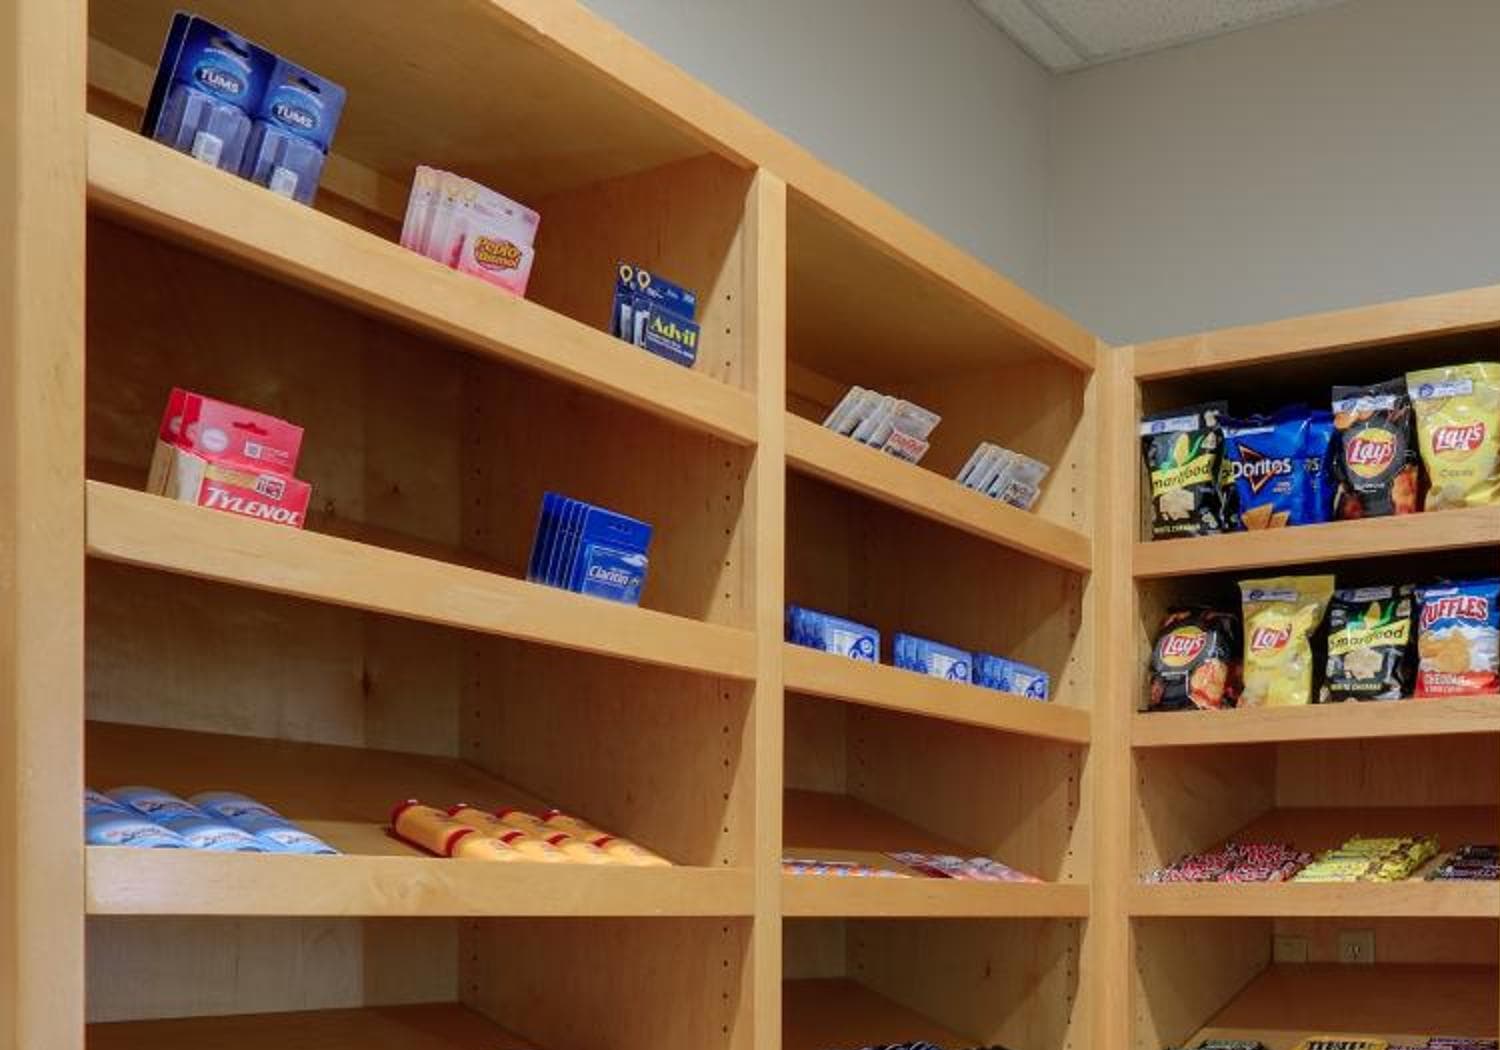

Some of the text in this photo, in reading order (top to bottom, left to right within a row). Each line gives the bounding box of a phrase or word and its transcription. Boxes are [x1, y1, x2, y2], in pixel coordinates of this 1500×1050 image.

[201, 67, 240, 93] TUMS
[276, 104, 313, 129] TUMS
[651, 314, 697, 348] Advil
[1436, 421, 1485, 452] Lay's
[1152, 461, 1210, 490] martfood
[1232, 457, 1292, 479] Doritos
[206, 487, 300, 525] TYLENOL
[589, 565, 629, 585] Claritin
[1163, 634, 1203, 657] Lay's
